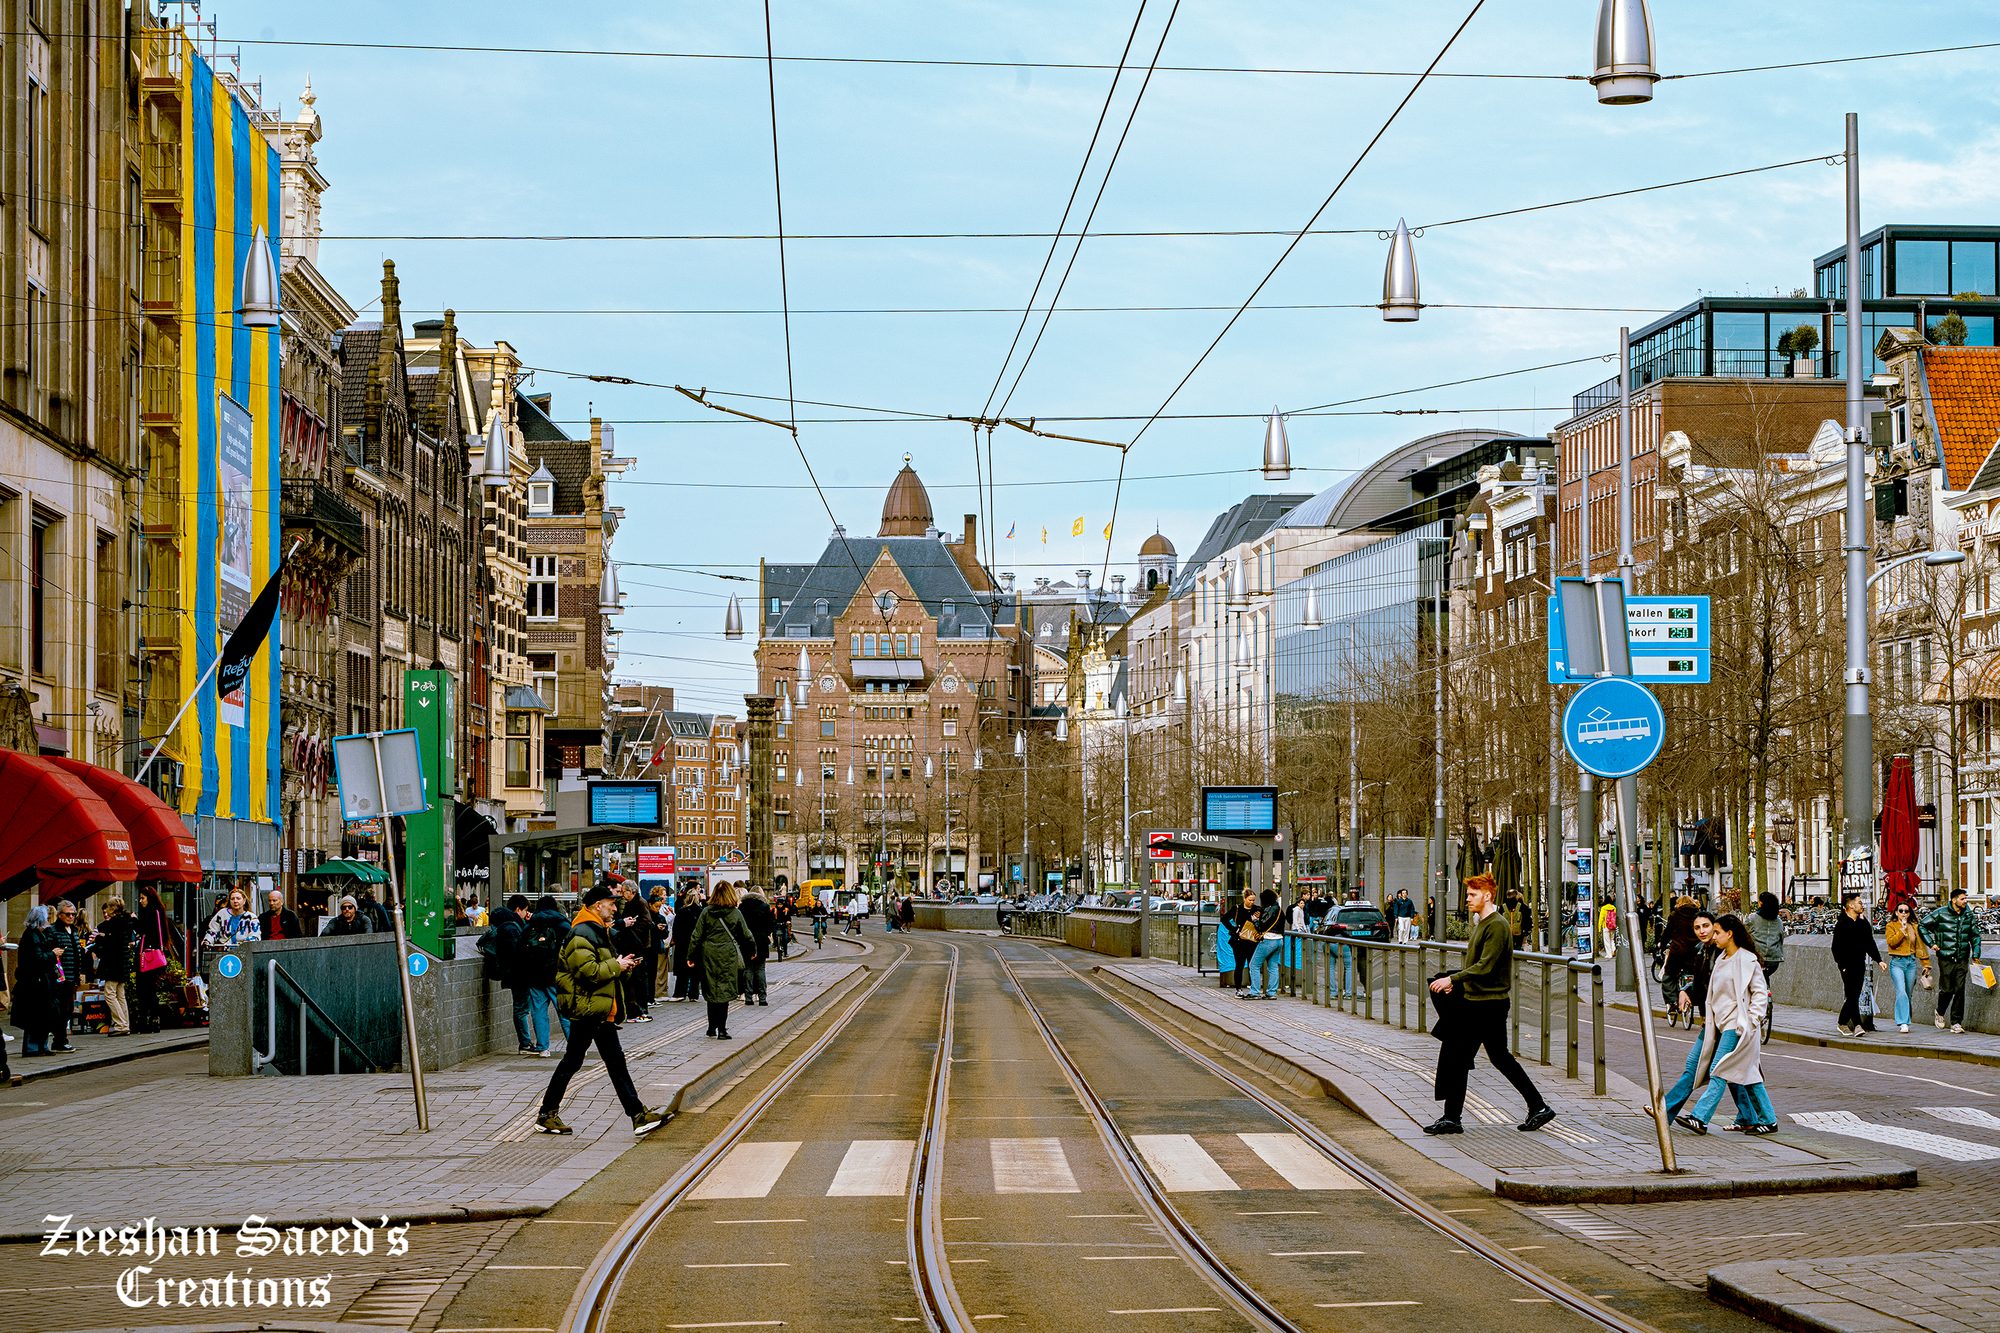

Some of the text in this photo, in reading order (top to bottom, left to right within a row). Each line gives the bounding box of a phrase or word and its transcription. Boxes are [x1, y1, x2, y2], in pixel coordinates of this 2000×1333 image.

[1671, 608, 1689, 619] 125
[1670, 627, 1689, 638] 250
[223, 654, 254, 677] Regu
[1677, 661, 1689, 671] 13
[412, 681, 420, 691] P
[1181, 832, 1219, 842] ROKIN
[1014, 866, 1019, 874] P
[1846, 860, 1870, 874] BEN
